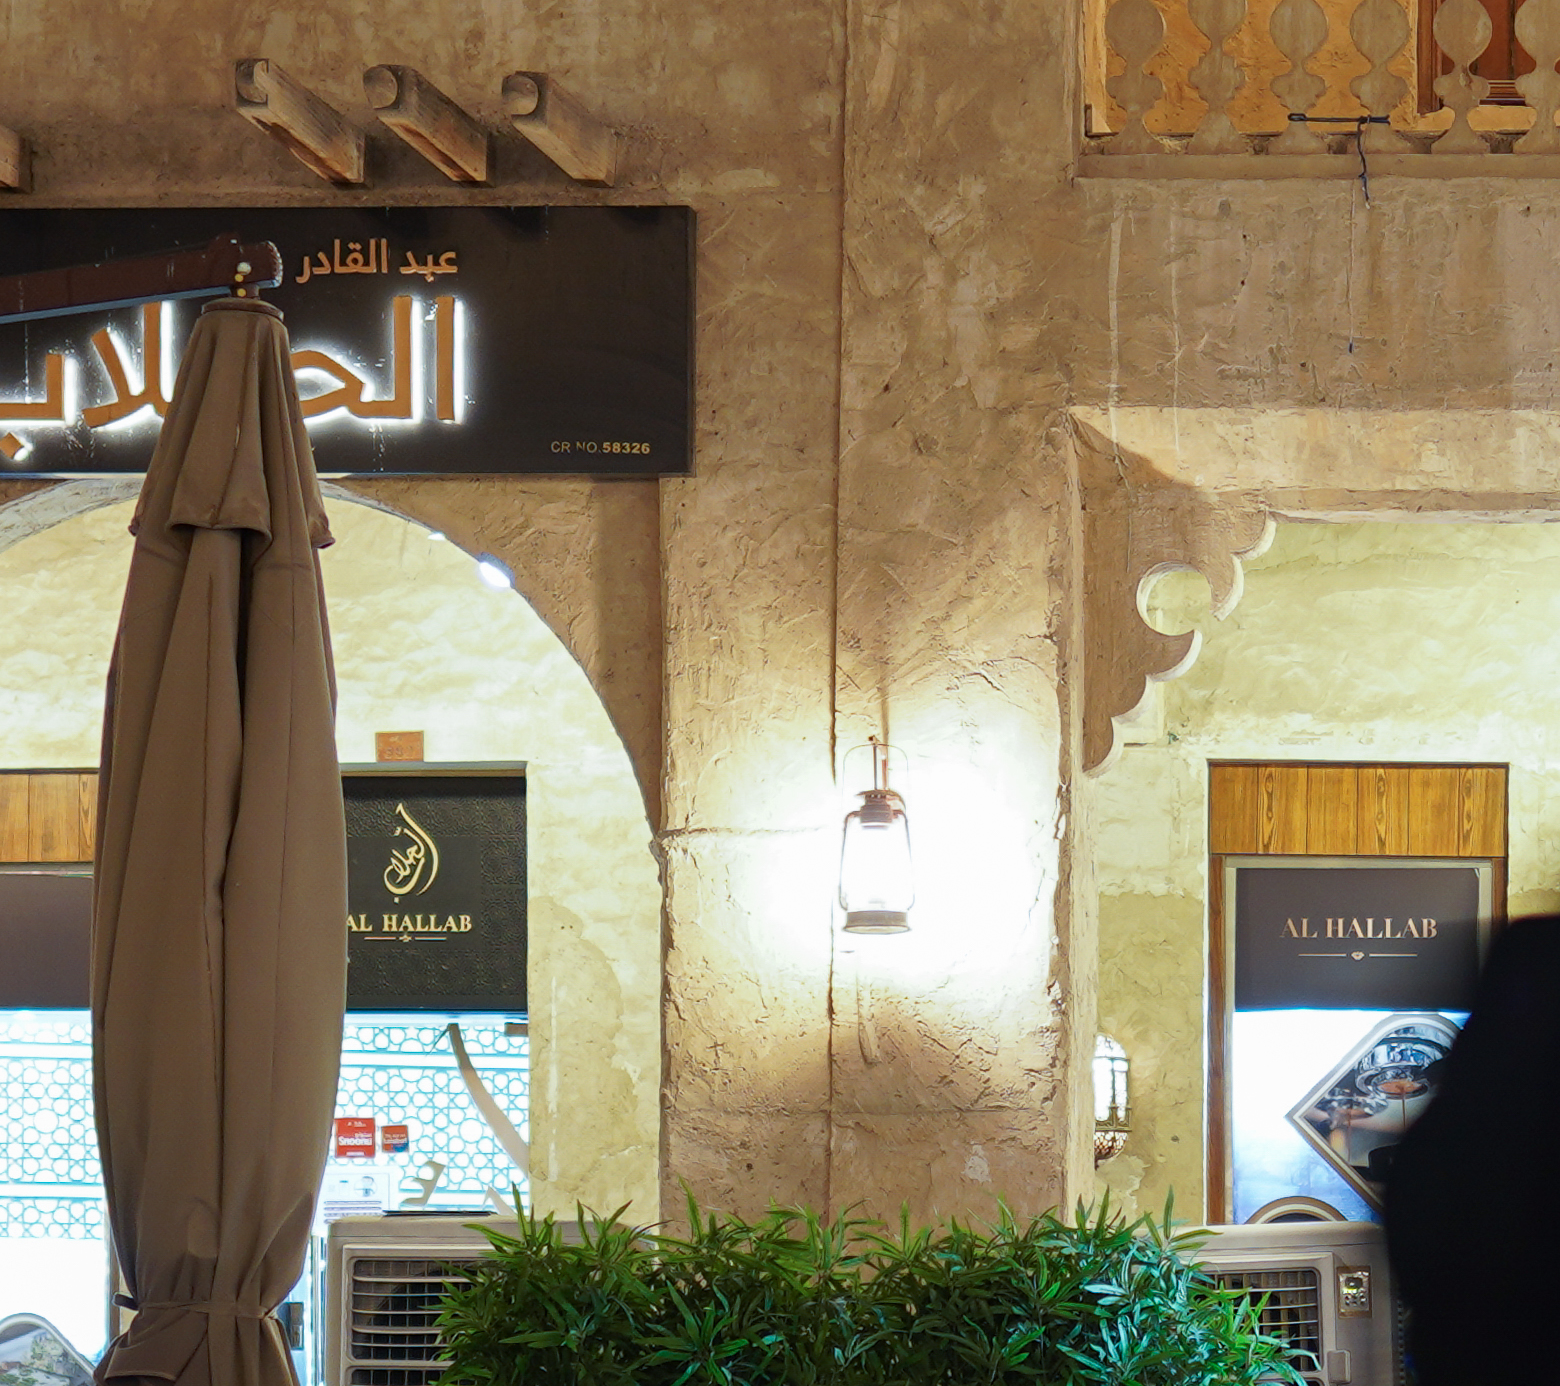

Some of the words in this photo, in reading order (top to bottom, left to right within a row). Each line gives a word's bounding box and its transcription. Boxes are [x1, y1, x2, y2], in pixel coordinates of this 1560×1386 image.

[295, 238, 388, 283] القادر
[399, 250, 458, 282] عبد
[550, 441, 571, 454] CR
[382, 914, 473, 933] HALLAB
[1280, 917, 1318, 938] AL
[1325, 917, 1439, 939] HALLAB
